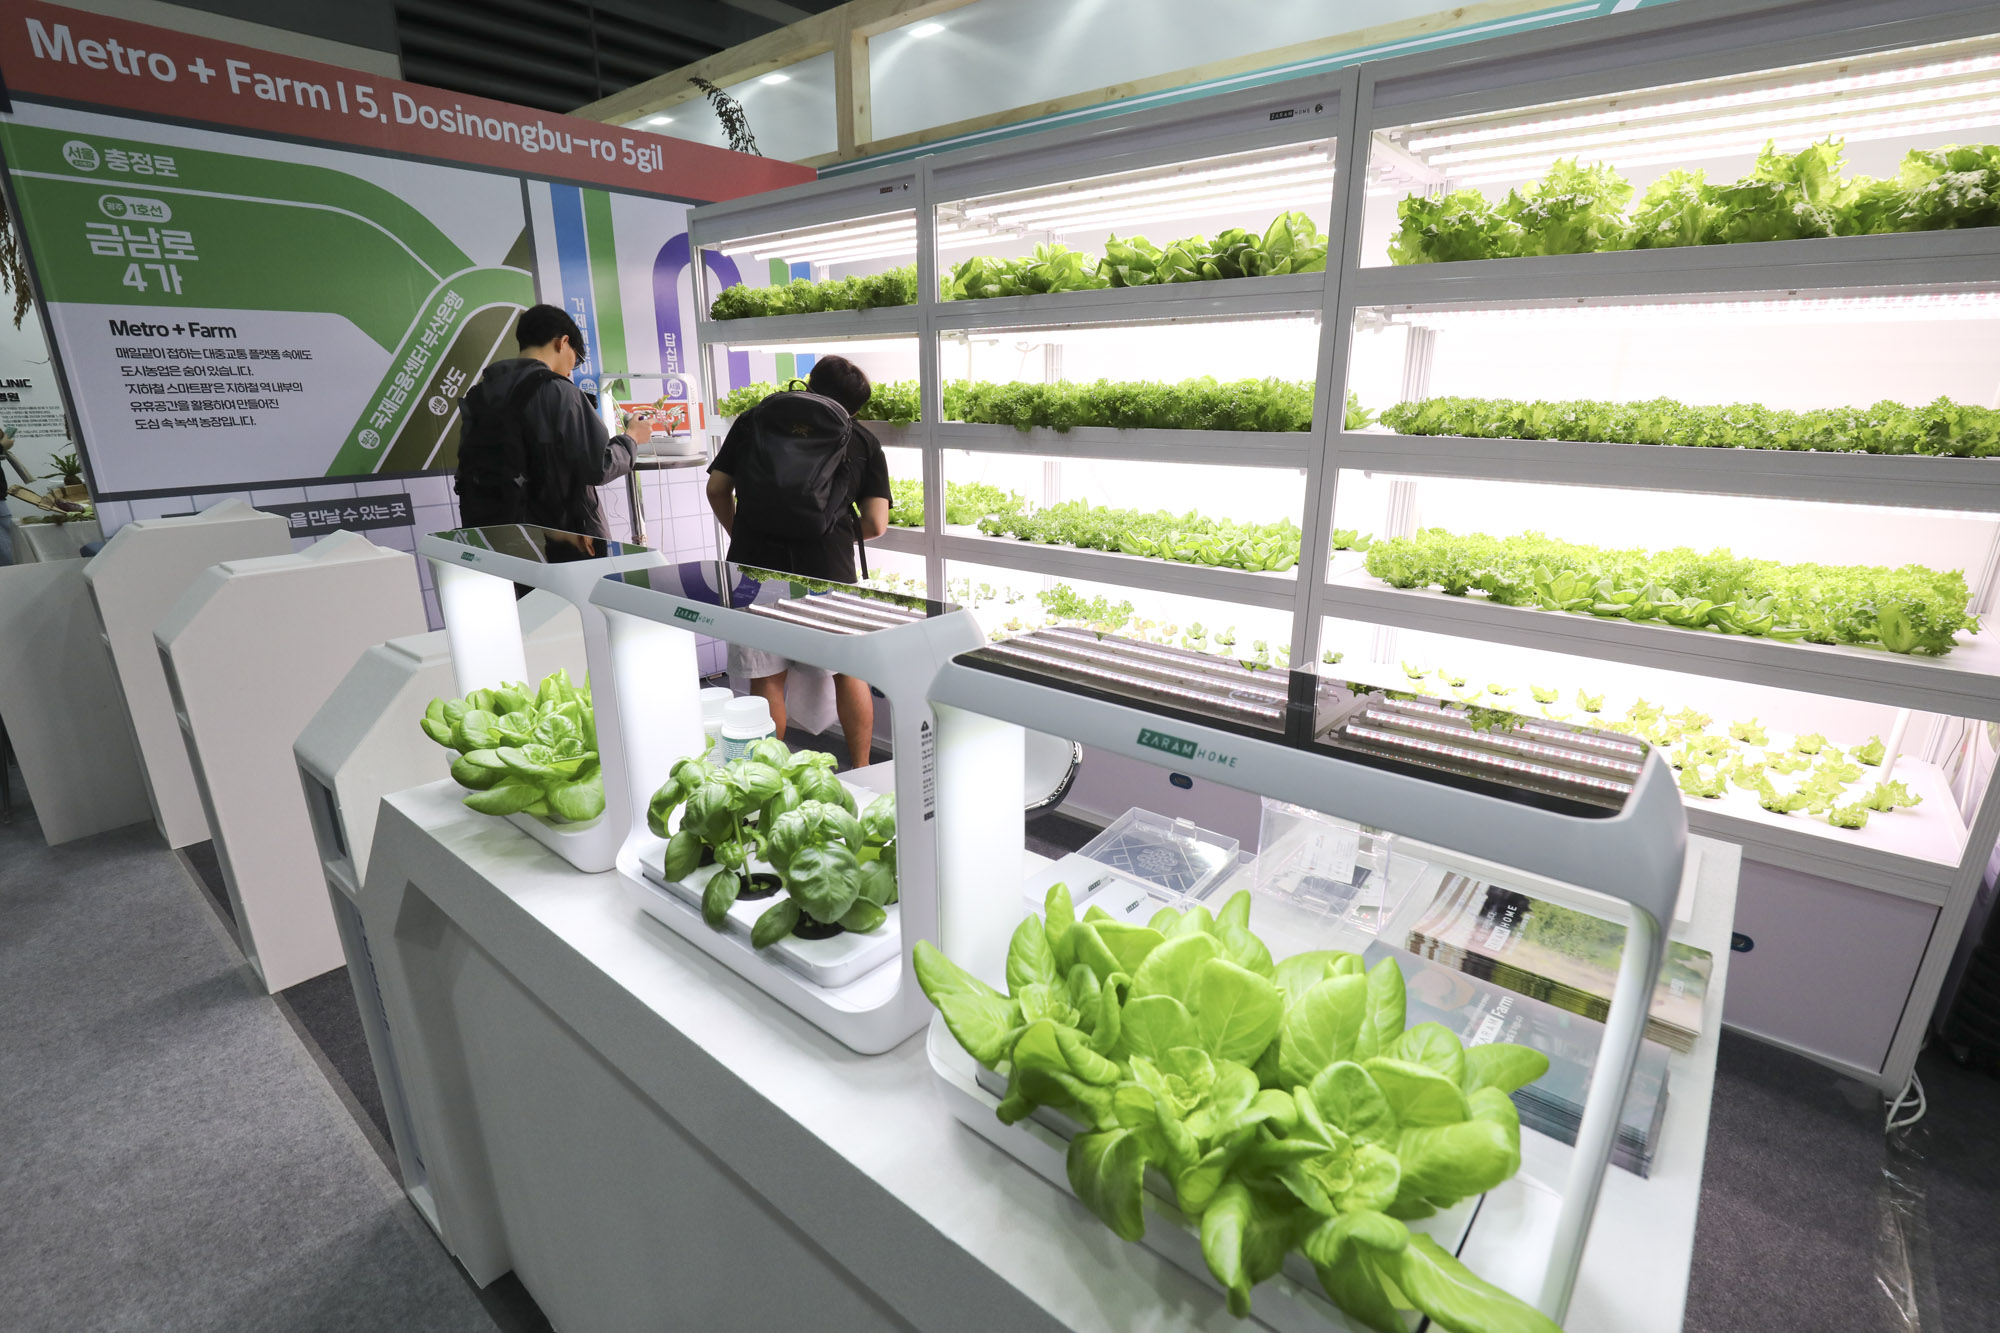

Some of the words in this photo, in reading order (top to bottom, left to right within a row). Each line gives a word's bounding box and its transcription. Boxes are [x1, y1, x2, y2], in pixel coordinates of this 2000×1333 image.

[25, 17, 177, 82] Metro
[187, 57, 216, 84] +
[226, 58, 331, 111] Farm
[355, 84, 388, 124] 5,
[392, 91, 616, 162] Dosinongbu-ro
[621, 138, 664, 173] 5gil
[68, 145, 96, 160] 서울
[104, 148, 180, 178] 충정로
[106, 201, 124, 211] 광주
[129, 203, 164, 218] 1호선
[85, 221, 200, 261] 금남로
[122, 262, 184, 295] 4가
[109, 320, 170, 337] Metro
[172, 323, 186, 336] +
[188, 322, 238, 338] Farm
[571, 297, 593, 376] 거제이
[115, 347, 166, 359] 매일같이
[167, 348, 202, 360] 접하는
[203, 349, 248, 360] 대중교통
[249, 349, 281, 360] 플랫폼
[281, 349, 313, 360] 속에도
[664, 332, 679, 375] 답십리
[120, 366, 182, 377] 도시농업은
[183, 366, 206, 377] 숨어
[207, 365, 254, 377] 있습니다.
[440, 366, 467, 398] 상도
[226, 382, 259, 393] 지하철
[260, 382, 271, 392] 역
[272, 382, 304, 393] 내부의
[130, 400, 189, 413] 유휴공간을
[190, 400, 236, 412] 활용하여
[237, 399, 279, 410] 만들어진
[135, 418, 160, 431] 도심
[161, 418, 174, 430] 속
[174, 417, 199, 428] 녹색
[199, 416, 257, 428] 농장입니다.
[361, 430, 377, 446] 부산
[288, 511, 309, 528] 을
[308, 508, 342, 527] 만날
[342, 507, 359, 523] 수
[359, 504, 391, 522] 있는
[390, 502, 407, 518] 곳
[1139, 729, 1196, 756] ZARAM
[1197, 747, 1240, 769] HOME
[1500, 904, 1518, 929] HOME
[1477, 1014, 1504, 1048] ARAM
[1491, 995, 1515, 1019] Farm
